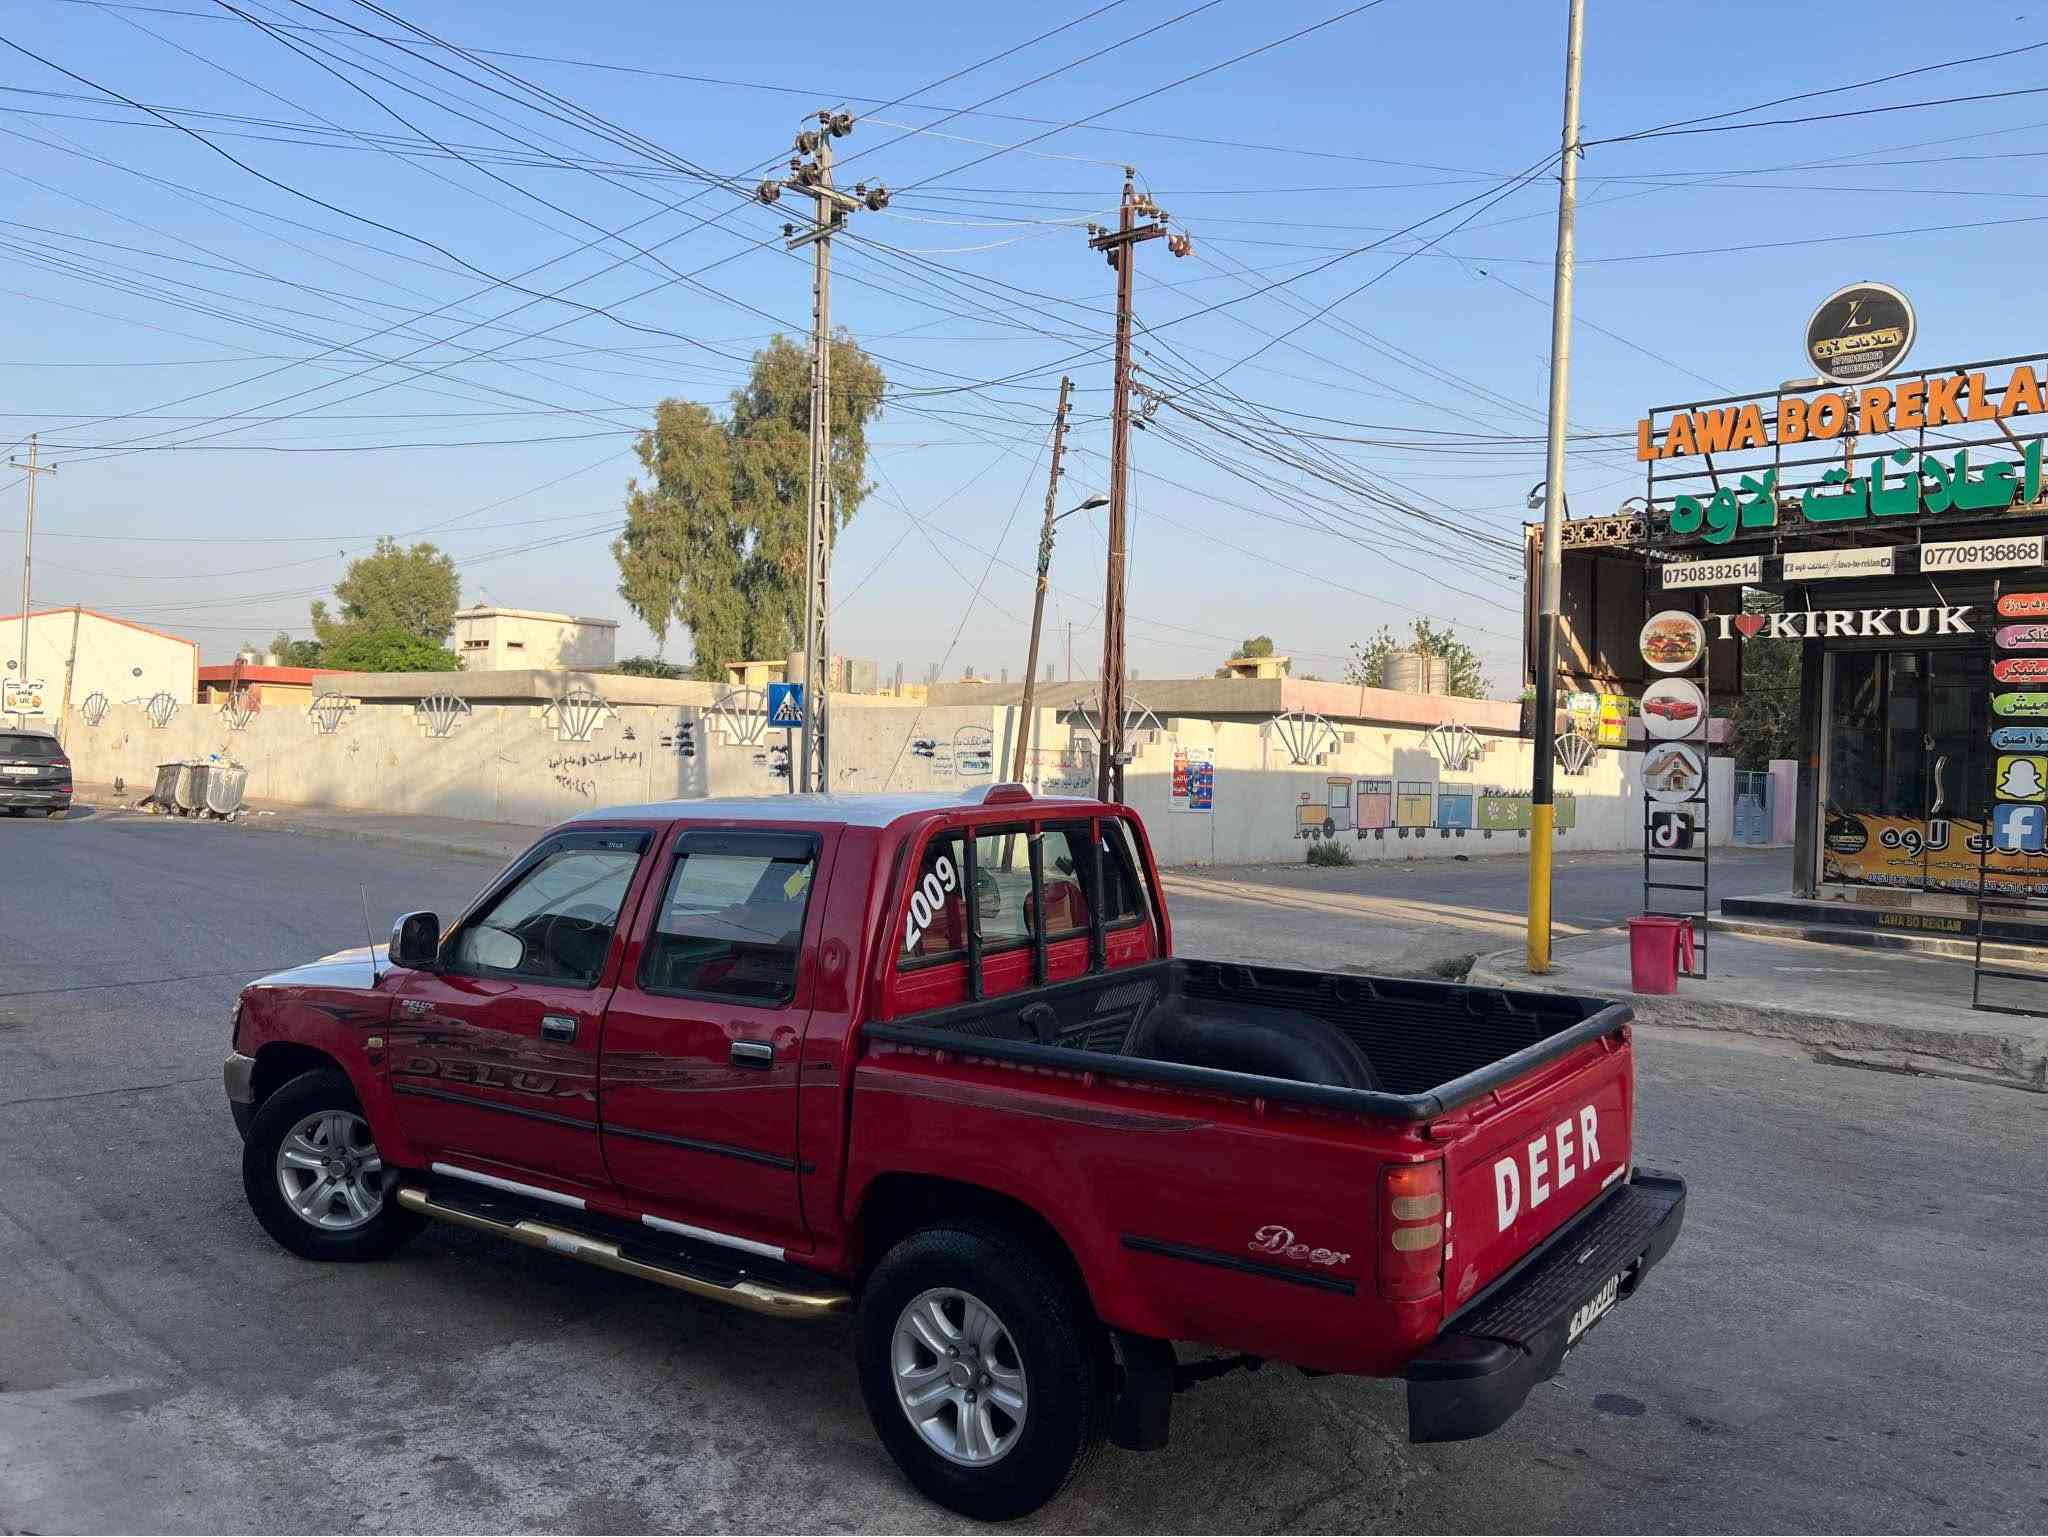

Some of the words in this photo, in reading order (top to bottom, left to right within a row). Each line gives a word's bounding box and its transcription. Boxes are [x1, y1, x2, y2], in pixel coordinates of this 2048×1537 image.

[1637, 402, 1769, 461] LAWA
[1776, 393, 1850, 445] BO
[1860, 366, 2048, 435] REKLA
[1670, 468, 1778, 545] لاوه
[1802, 438, 2043, 522] اعلانات
[1663, 562, 1758, 585] 07508382614
[1923, 543, 2039, 567] 07709136868
[1717, 613, 1734, 639] I
[1768, 605, 1976, 639] KIRKUK
[905, 855, 957, 953] 2009
[1494, 1104, 1601, 1233] DEER
[1247, 1225, 1352, 1266] Deer
